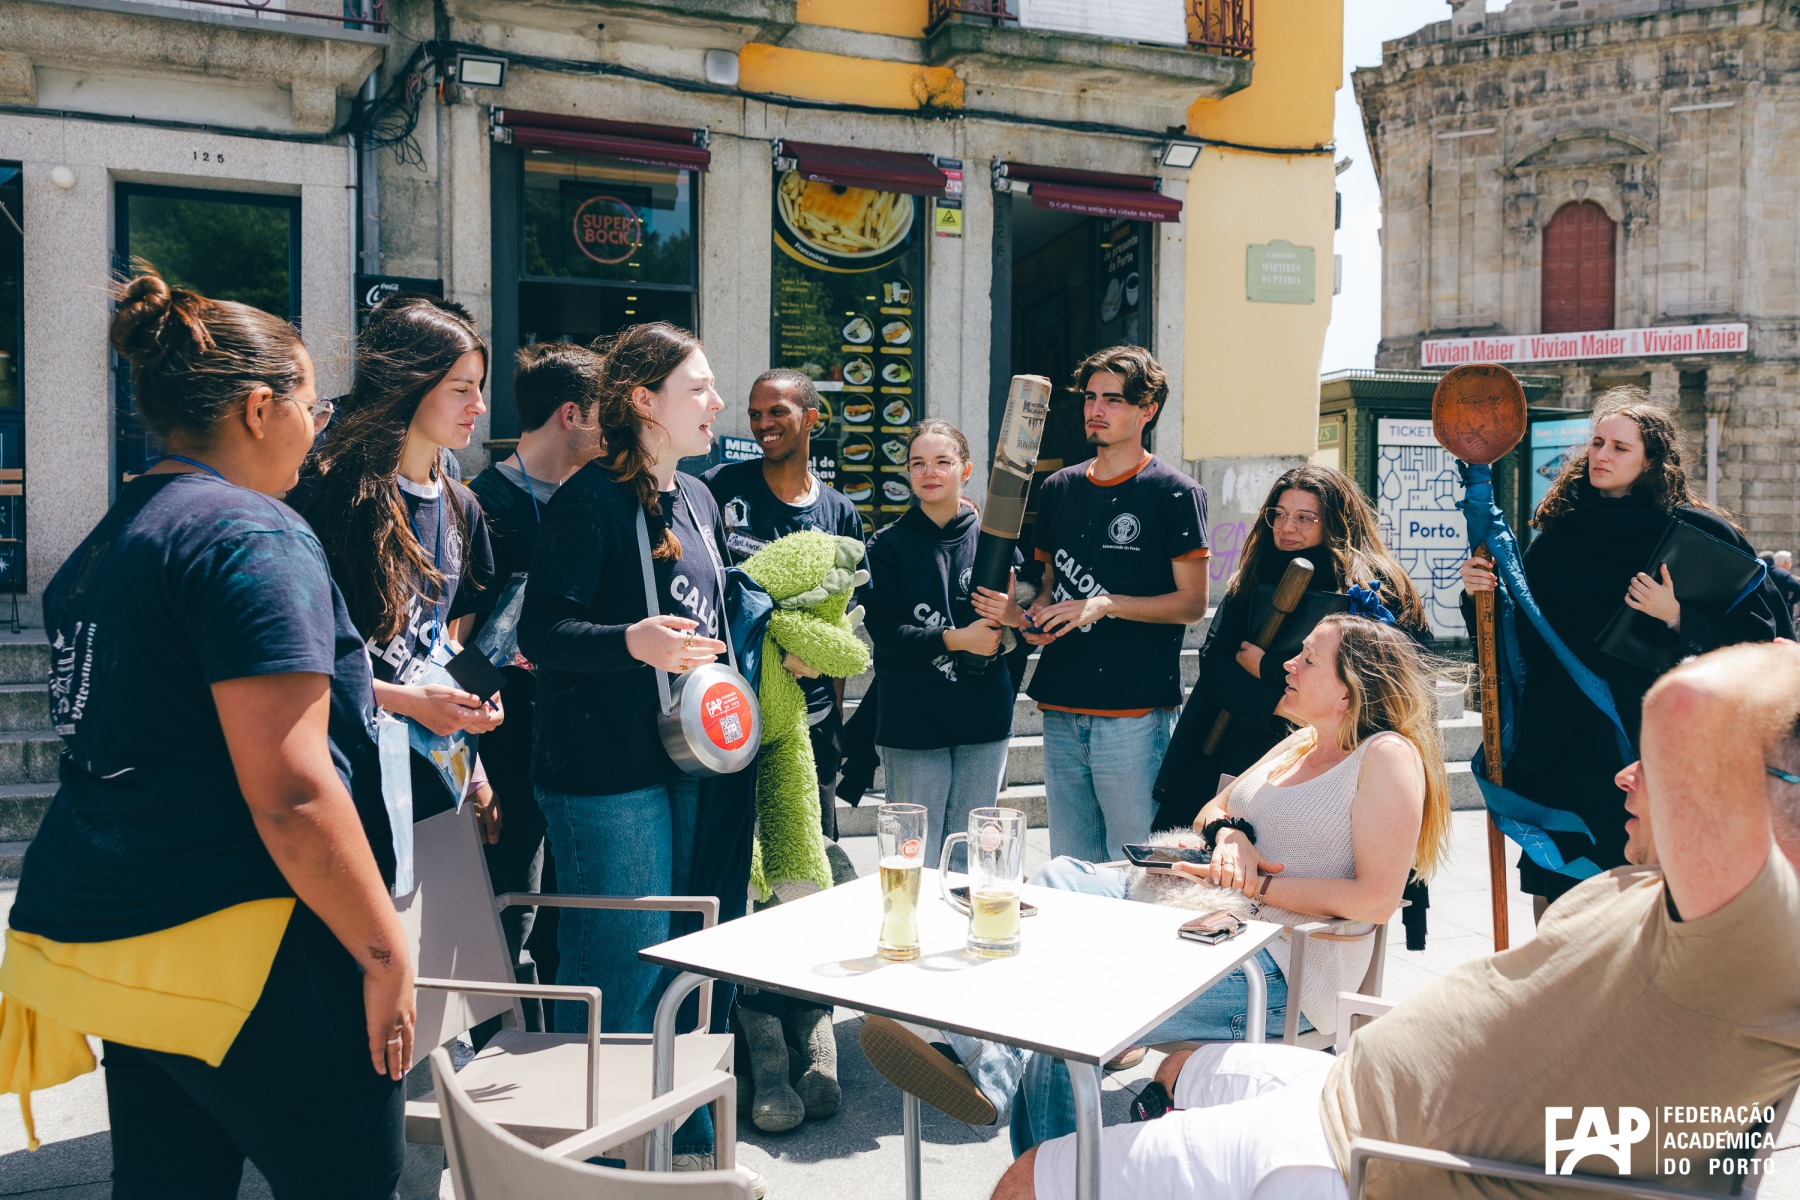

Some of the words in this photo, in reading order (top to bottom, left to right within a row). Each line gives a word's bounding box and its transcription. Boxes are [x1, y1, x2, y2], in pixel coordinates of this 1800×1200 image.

[193, 151, 224, 163] 125
[1072, 204, 1086, 212] mais
[1088, 205, 1107, 214] antigo
[1118, 208, 1137, 217] cidade
[1139, 210, 1147, 218] do
[1148, 211, 1165, 219] Porto
[582, 214, 632, 231] SUPER
[584, 228, 631, 245] BOCK
[1531, 335, 1577, 359] Vivian
[1581, 333, 1626, 356] Maier
[1642, 330, 1692, 353] Vivian
[1696, 327, 1744, 350] Maier
[1425, 342, 1469, 364] Vivian
[1473, 339, 1515, 361] Maier
[1389, 425, 1433, 438] TICKET
[820, 456, 835, 468] de
[1409, 521, 1460, 538] Porto.
